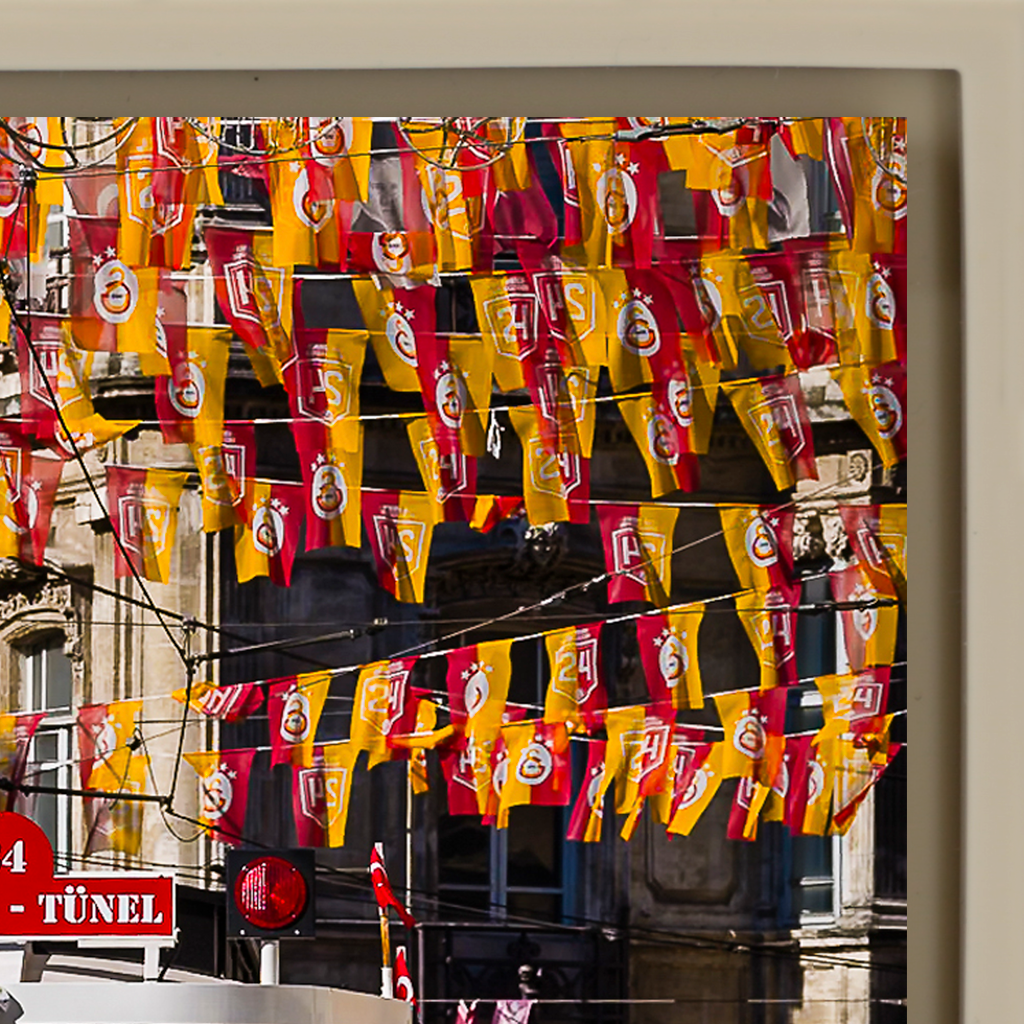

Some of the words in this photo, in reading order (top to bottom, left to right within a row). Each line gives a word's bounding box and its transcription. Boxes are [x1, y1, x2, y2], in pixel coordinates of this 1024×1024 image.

[558, 648, 592, 681] 24
[367, 679, 400, 713] 24
[38, 884, 164, 925] TÜNEL
